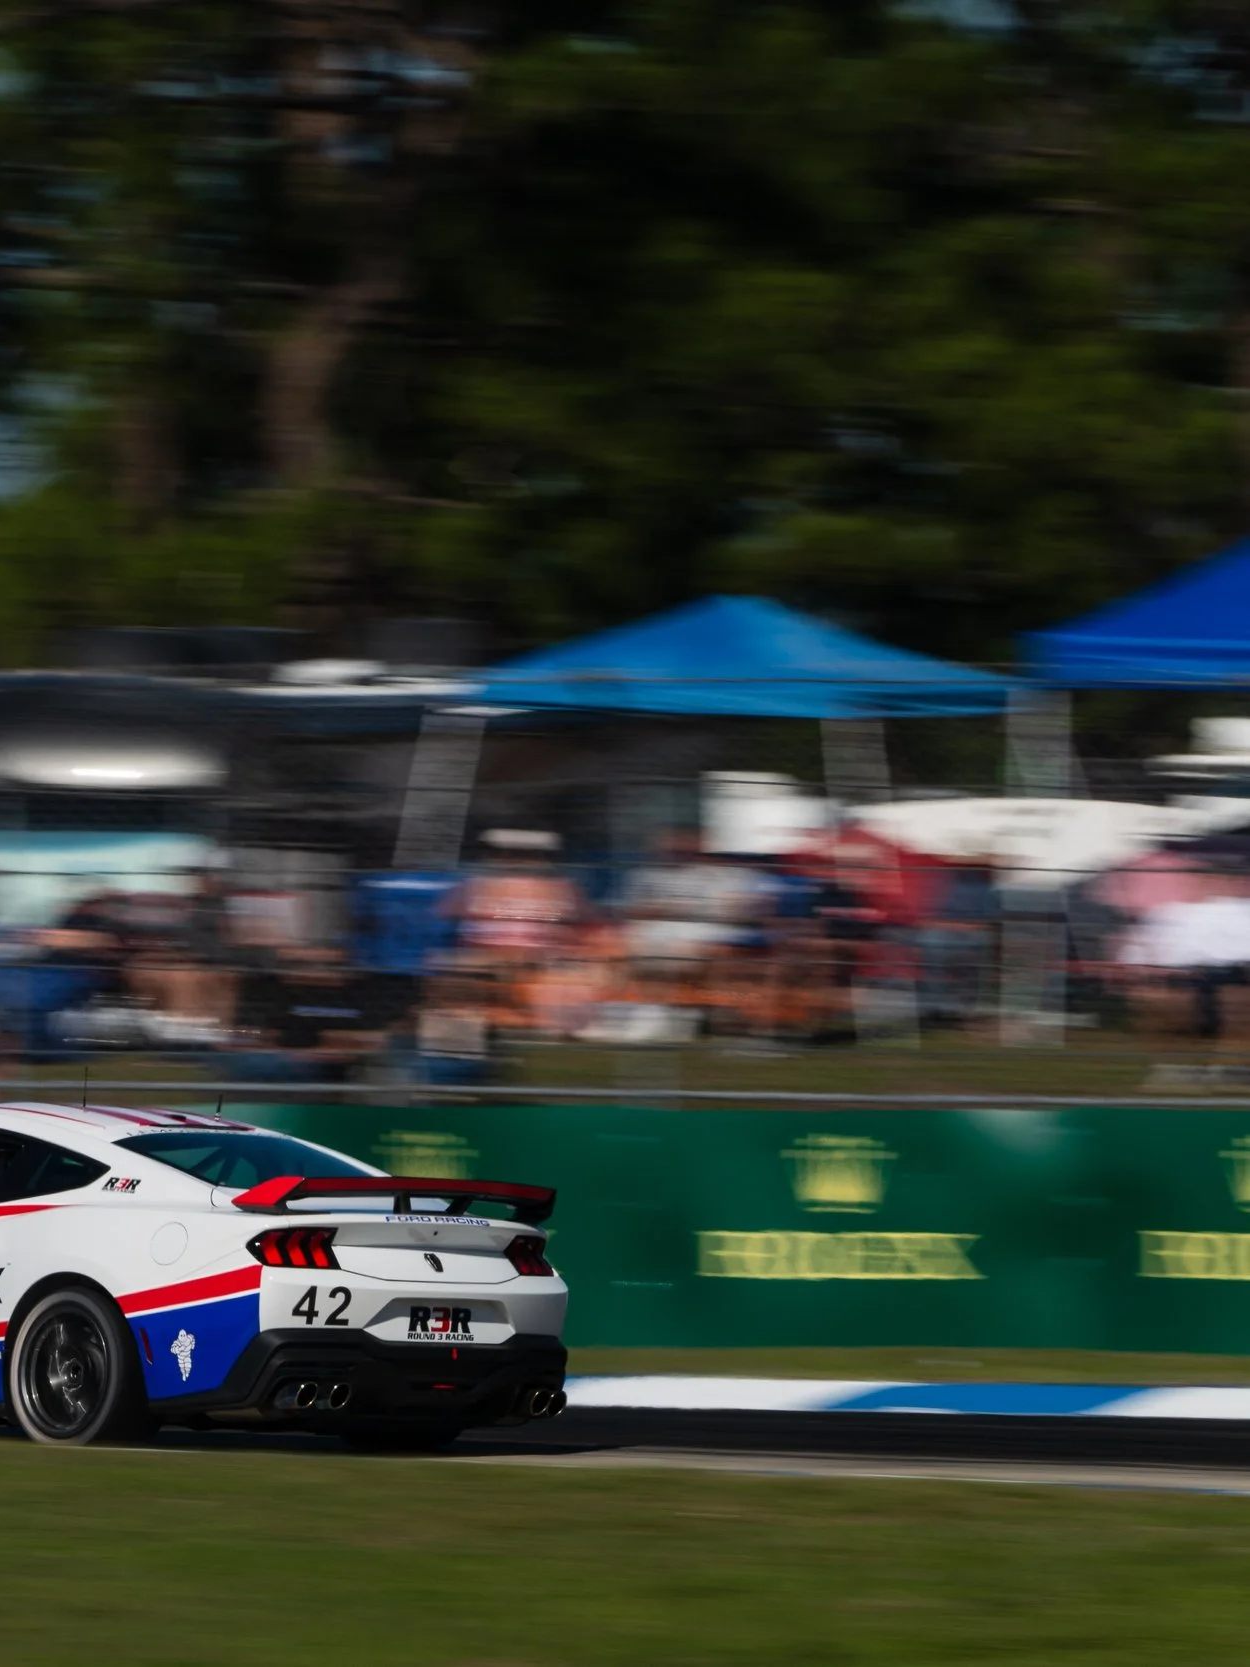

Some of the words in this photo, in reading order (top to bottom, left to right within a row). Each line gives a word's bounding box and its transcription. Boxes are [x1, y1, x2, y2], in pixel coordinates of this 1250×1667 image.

[104, 1176, 141, 1190] R3R
[434, 1216, 490, 1227] RACING
[291, 1285, 352, 1326] 42
[407, 1305, 472, 1334] R3R
[407, 1332, 435, 1341] ROUND
[437, 1333, 443, 1341] 3
[445, 1333, 475, 1342] RACING
